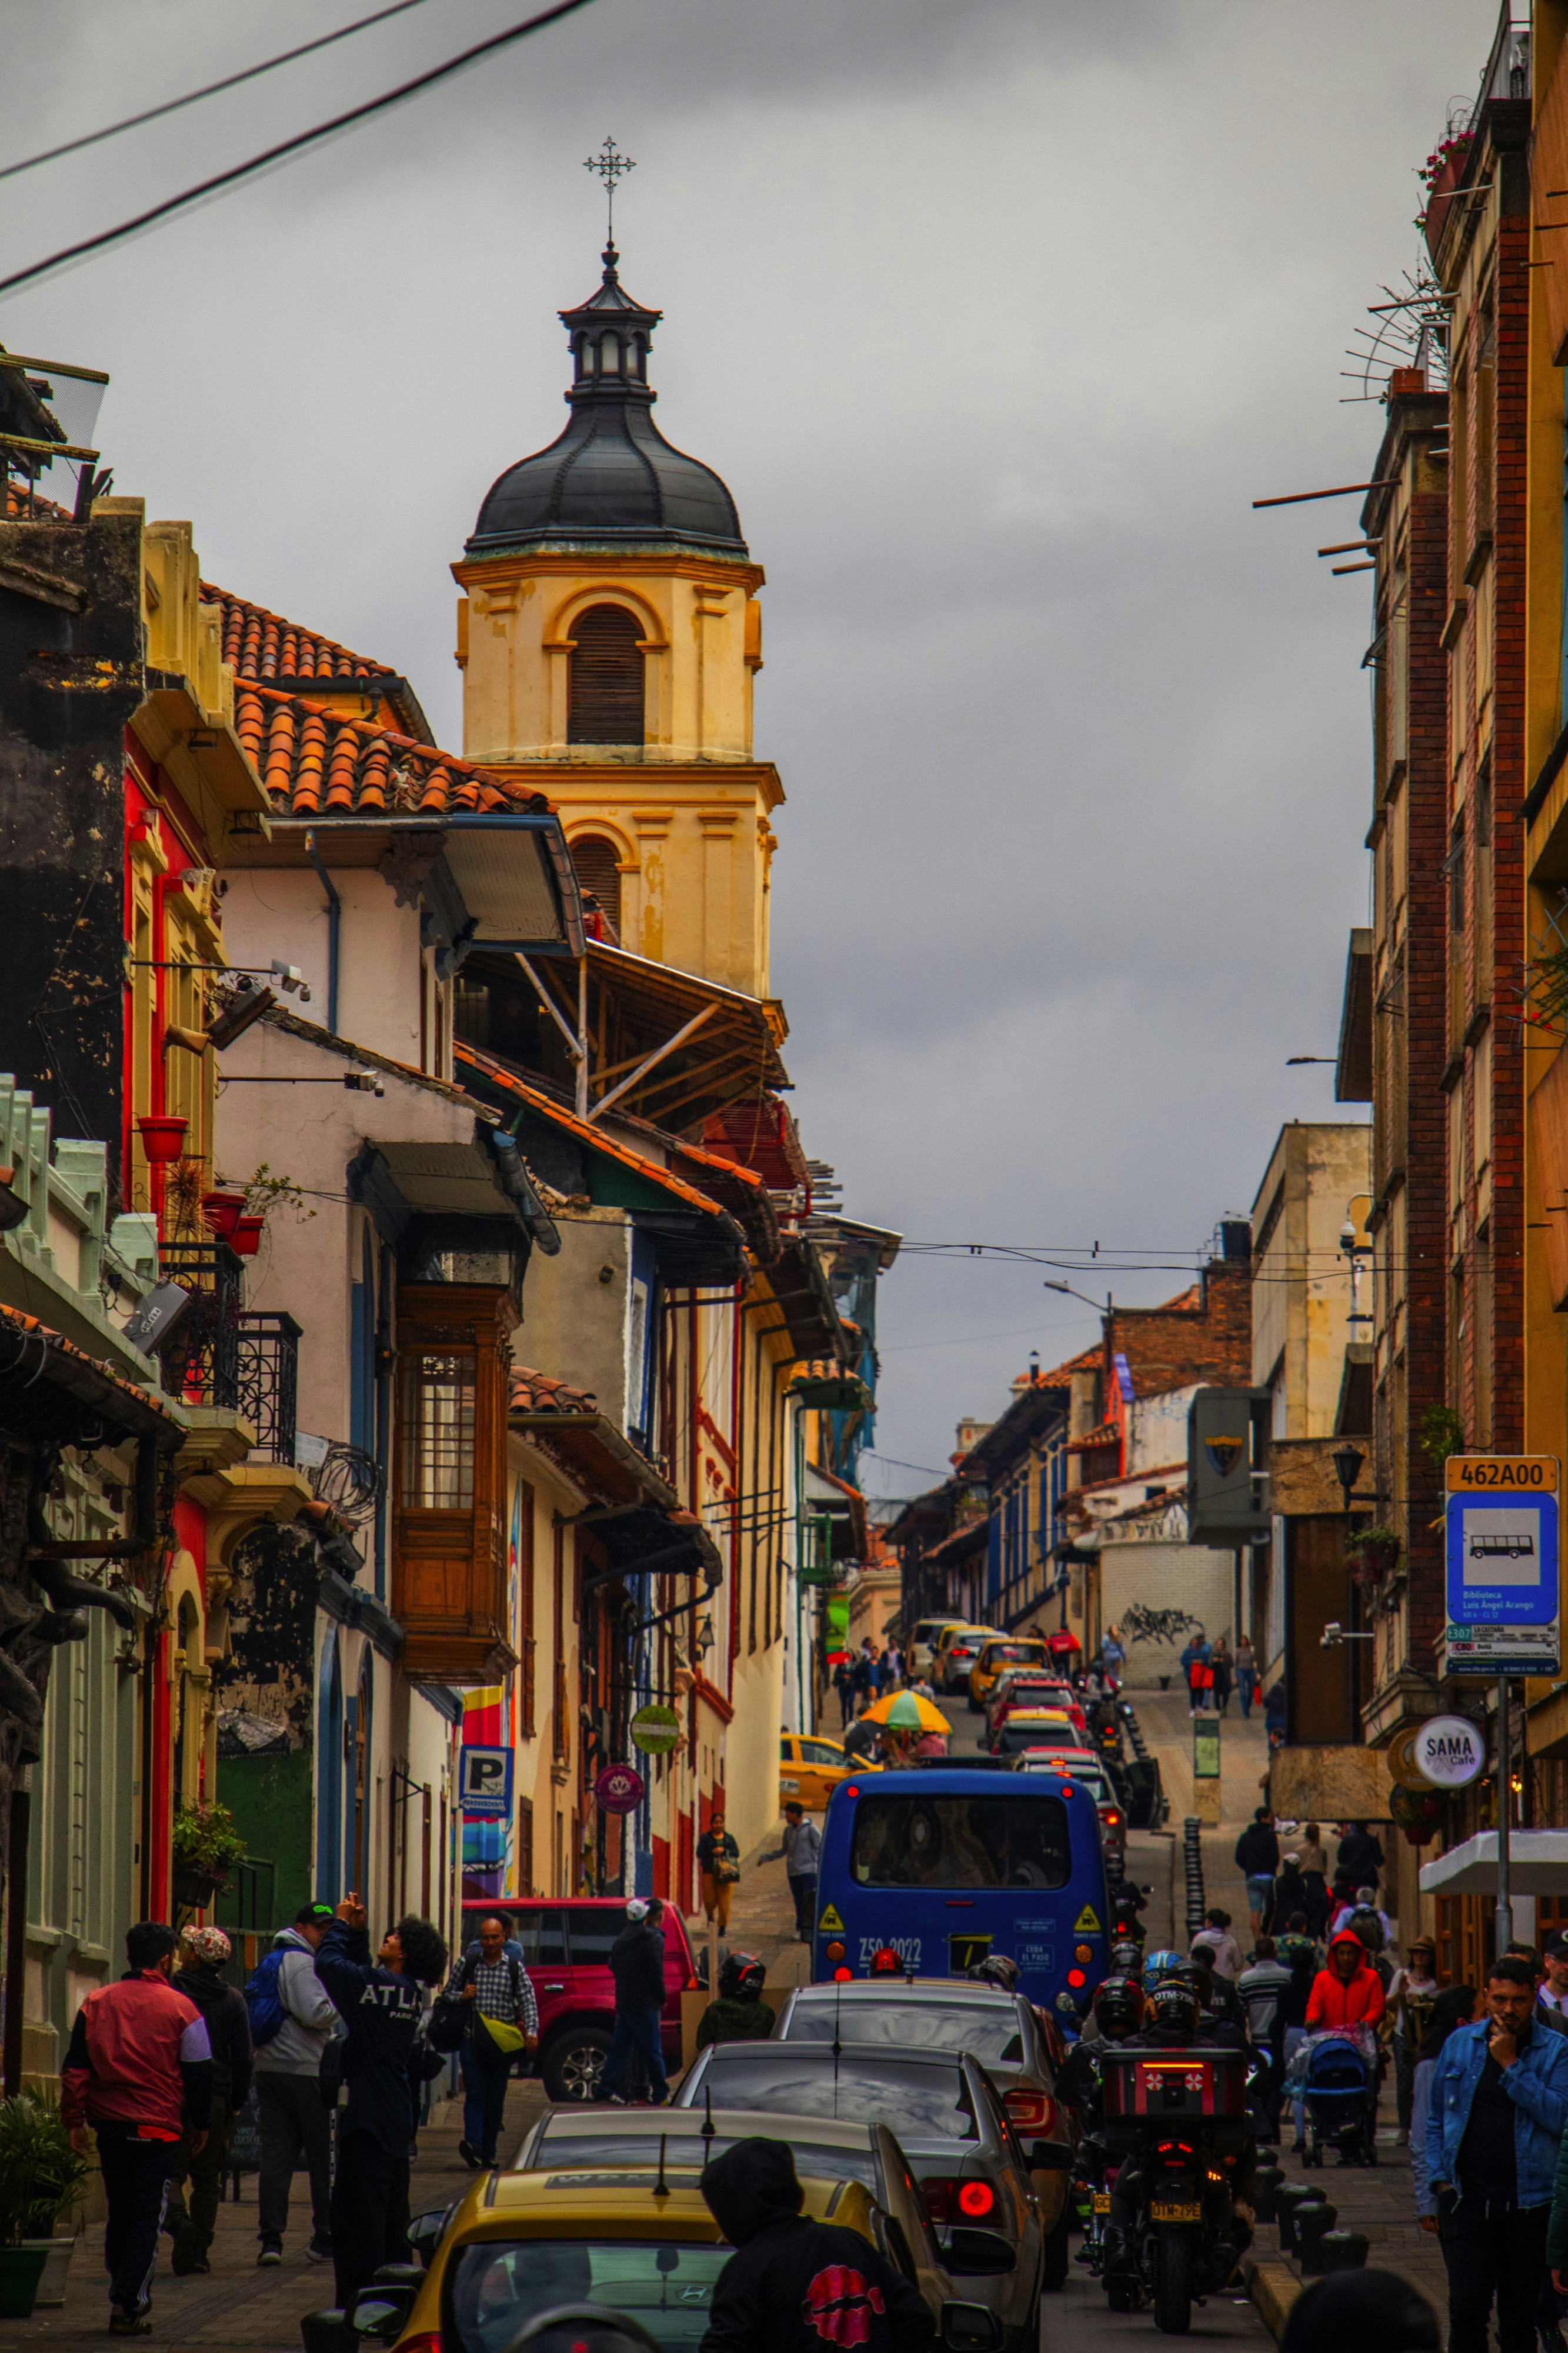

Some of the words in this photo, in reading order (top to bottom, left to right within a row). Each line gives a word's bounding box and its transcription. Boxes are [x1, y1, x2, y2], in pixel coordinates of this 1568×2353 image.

[1461, 1464, 1542, 1484] 462A00
[1463, 1601, 1479, 1609] Luis
[1482, 1599, 1503, 1611] Ángel
[1506, 1601, 1534, 1611] Arango
[1427, 1737, 1472, 1756] SAMA
[470, 1757, 503, 1789] P
